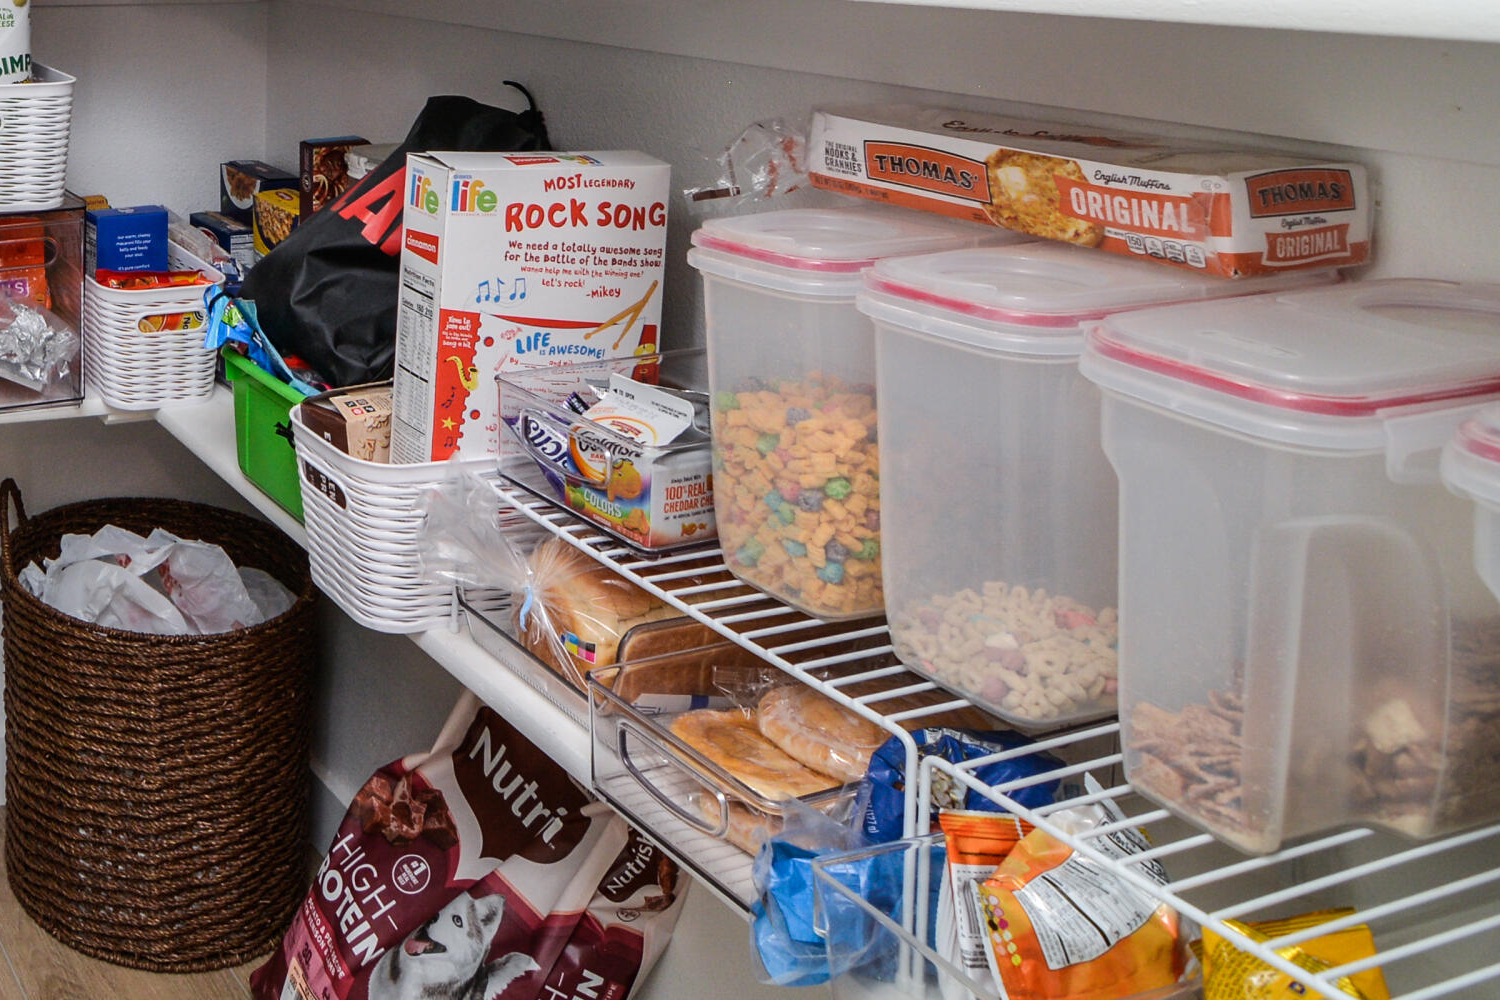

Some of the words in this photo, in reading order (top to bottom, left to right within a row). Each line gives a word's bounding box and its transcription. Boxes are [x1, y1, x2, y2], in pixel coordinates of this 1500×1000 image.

[824, 146, 850, 160] NOOKS
[824, 156, 862, 173] CRANNIES
[543, 173, 582, 193] MOST
[583, 178, 636, 190] LEGENDARY
[1094, 169, 1127, 187] English
[1128, 173, 1172, 193] Muffins
[410, 172, 439, 214] life
[451, 178, 498, 213] life
[505, 198, 589, 233] ROCK
[597, 201, 666, 230] SONG
[1069, 187, 1195, 233] ORIGINAL
[1280, 217, 1304, 228] English
[1304, 216, 1327, 225] Muffins
[406, 234, 437, 254] cinnamon
[508, 240, 524, 250] We
[526, 241, 549, 251] need
[561, 242, 597, 255] totally
[599, 245, 641, 256] awesome
[643, 248, 663, 259] song
[1275, 237, 1342, 258] ORIGINAL
[504, 251, 521, 262] for
[524, 252, 541, 263] the
[543, 254, 576, 265] Battle
[578, 255, 590, 267] of
[593, 255, 609, 267] the
[611, 257, 638, 267] Bands
[404, 266, 422, 280] Nutrition
[422, 275, 435, 287] Facts
[520, 265, 544, 275] Wanna
[547, 266, 561, 276] help
[574, 267, 590, 276] with
[591, 268, 602, 278] the
[604, 268, 627, 278] winning
[542, 277, 562, 287] Let's
[564, 278, 585, 289] rock!
[516, 332, 551, 354] LIFE
[550, 344, 606, 359] AWESOME!
[509, 357, 520, 365] By
[688, 482, 707, 498] REAL
[583, 486, 622, 518] COLORS
[664, 498, 699, 514] CHEDDAR
[318, 858, 384, 967] ROTEIN
